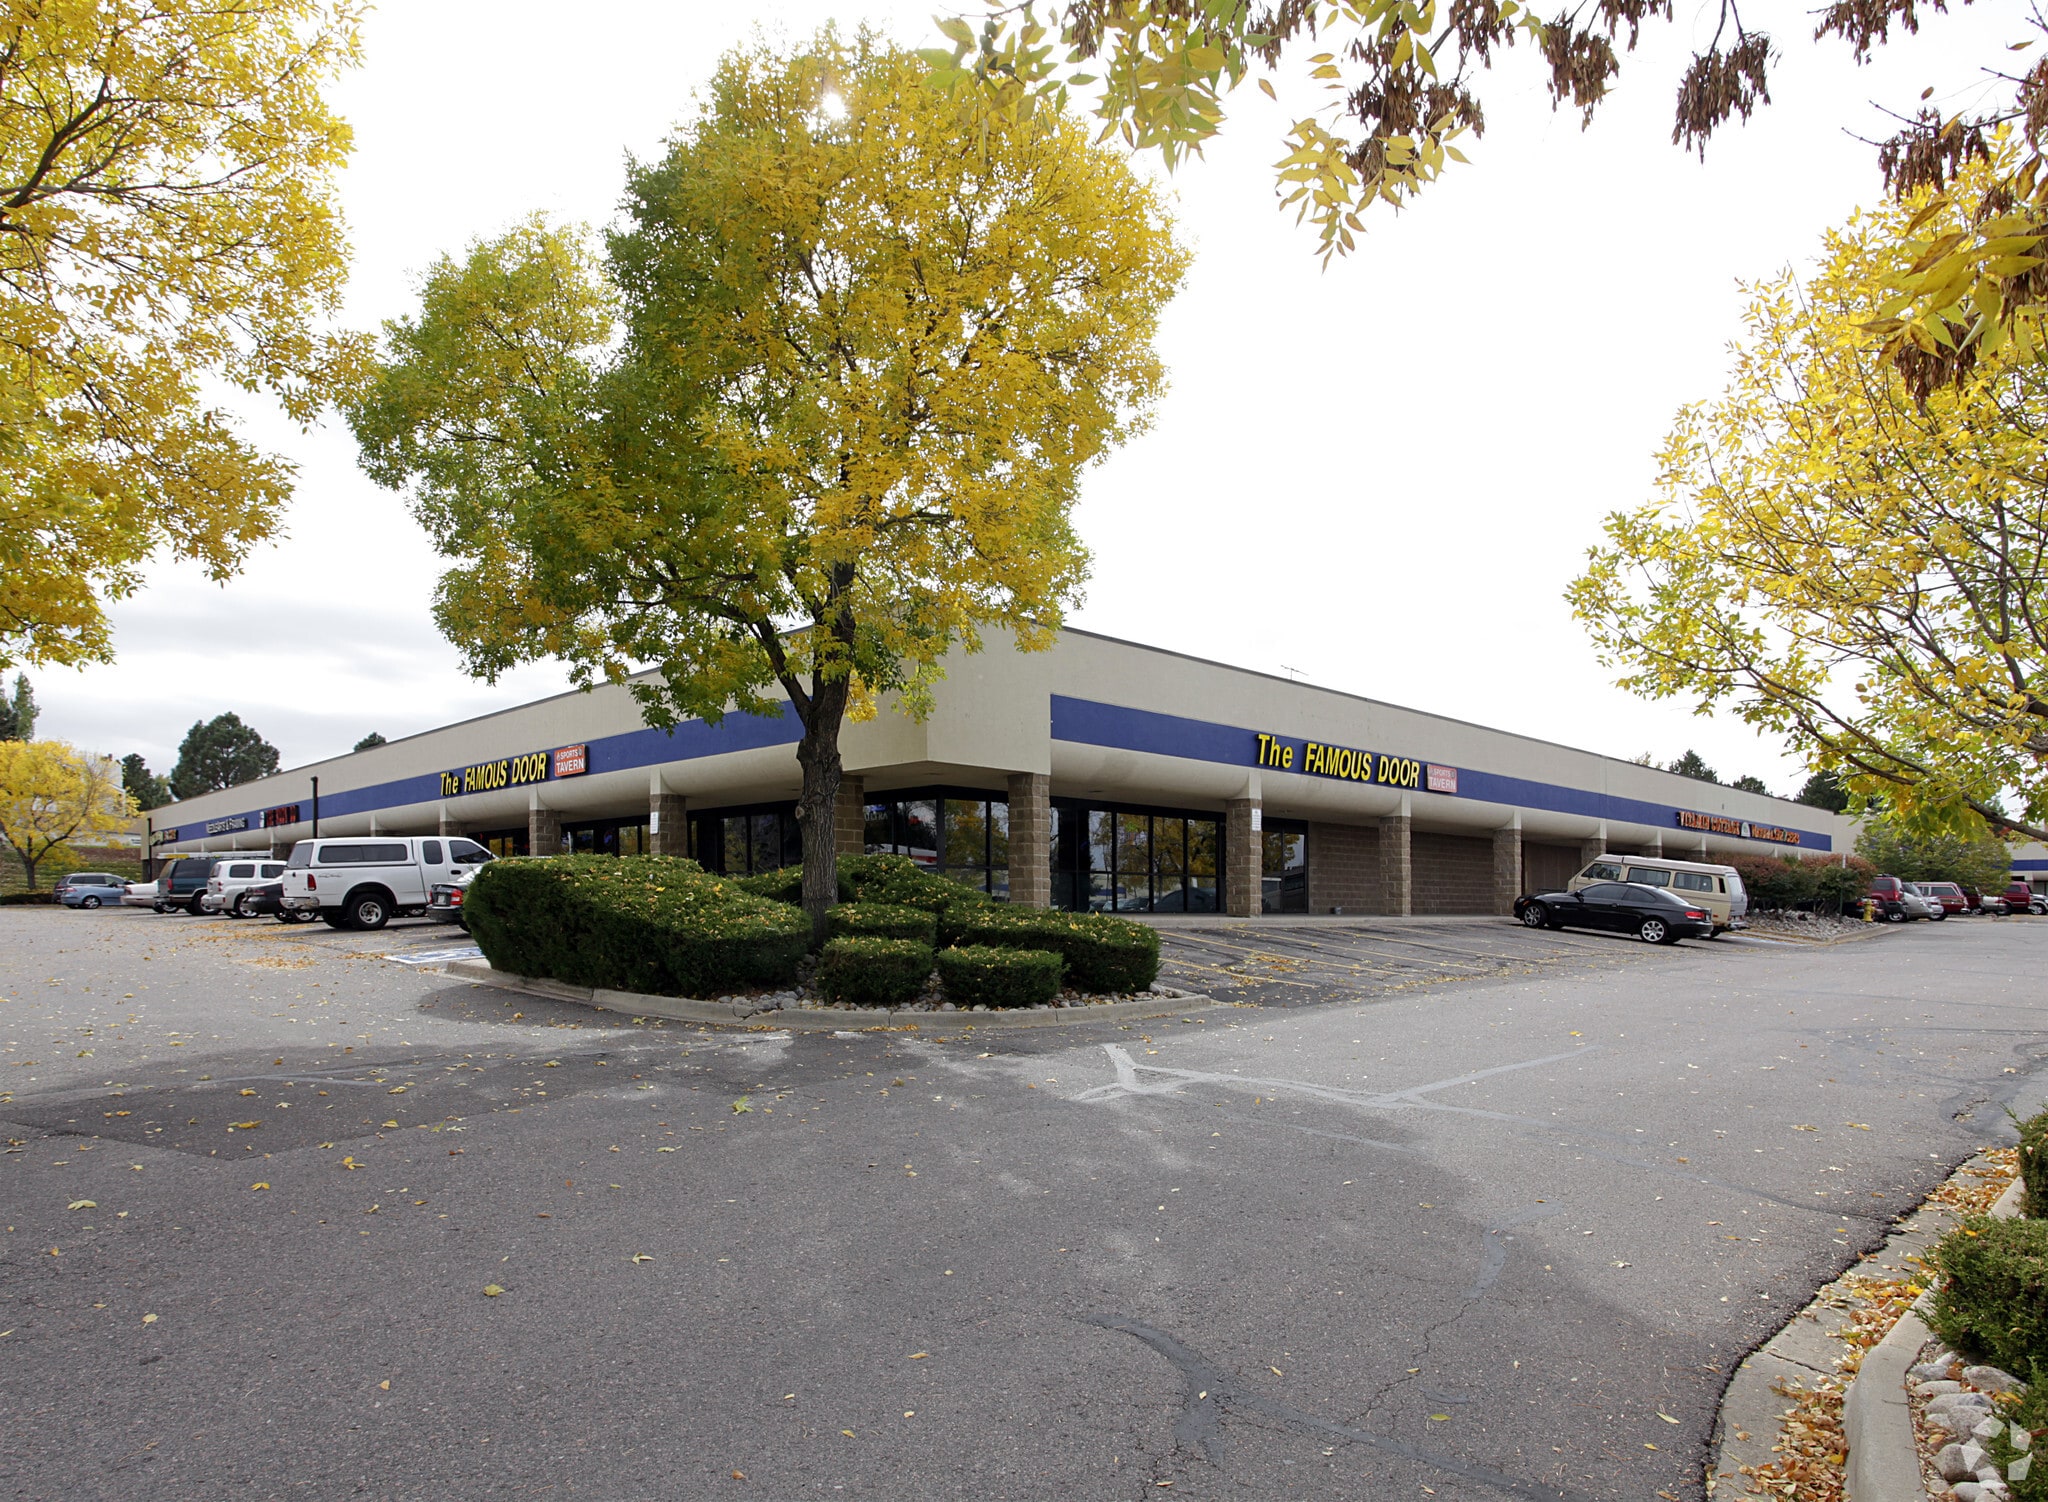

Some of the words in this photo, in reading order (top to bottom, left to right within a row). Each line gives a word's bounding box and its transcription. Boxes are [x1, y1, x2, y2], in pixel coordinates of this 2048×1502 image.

[561, 749, 579, 761] SPORTS
[1258, 733, 1293, 769] The
[1305, 742, 1372, 781] FAMOUS
[1378, 754, 1420, 788] DOOR
[556, 758, 585, 773] TAVERN
[440, 772, 459, 796] The
[464, 759, 508, 792] FAMOUS
[511, 752, 547, 784] DOOR
[1433, 769, 1451, 778] SPORTS
[1429, 776, 1456, 790] TAVERN
